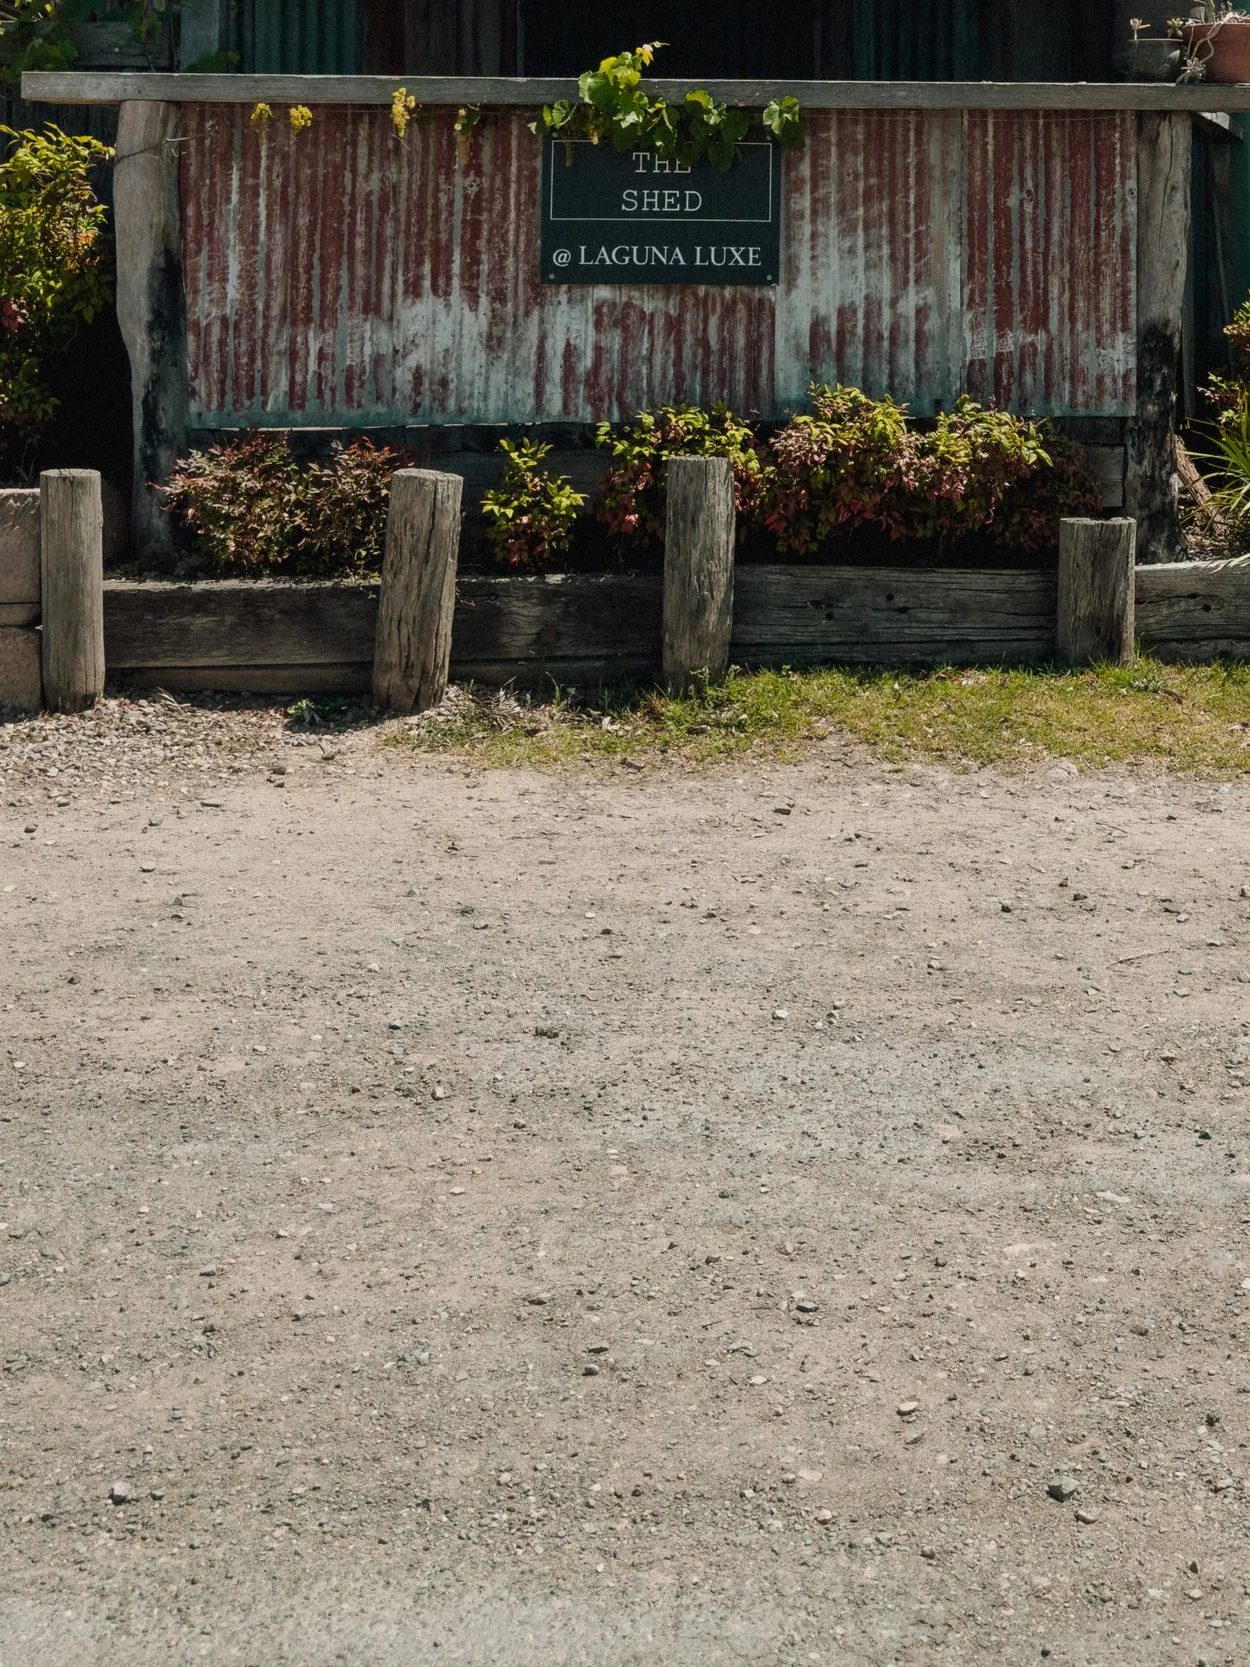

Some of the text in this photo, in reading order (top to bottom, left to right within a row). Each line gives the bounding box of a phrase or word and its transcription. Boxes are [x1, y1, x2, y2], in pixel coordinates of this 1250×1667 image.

[621, 189, 702, 212] SHED
[552, 245, 762, 267] @ LAGUNA LUXE
